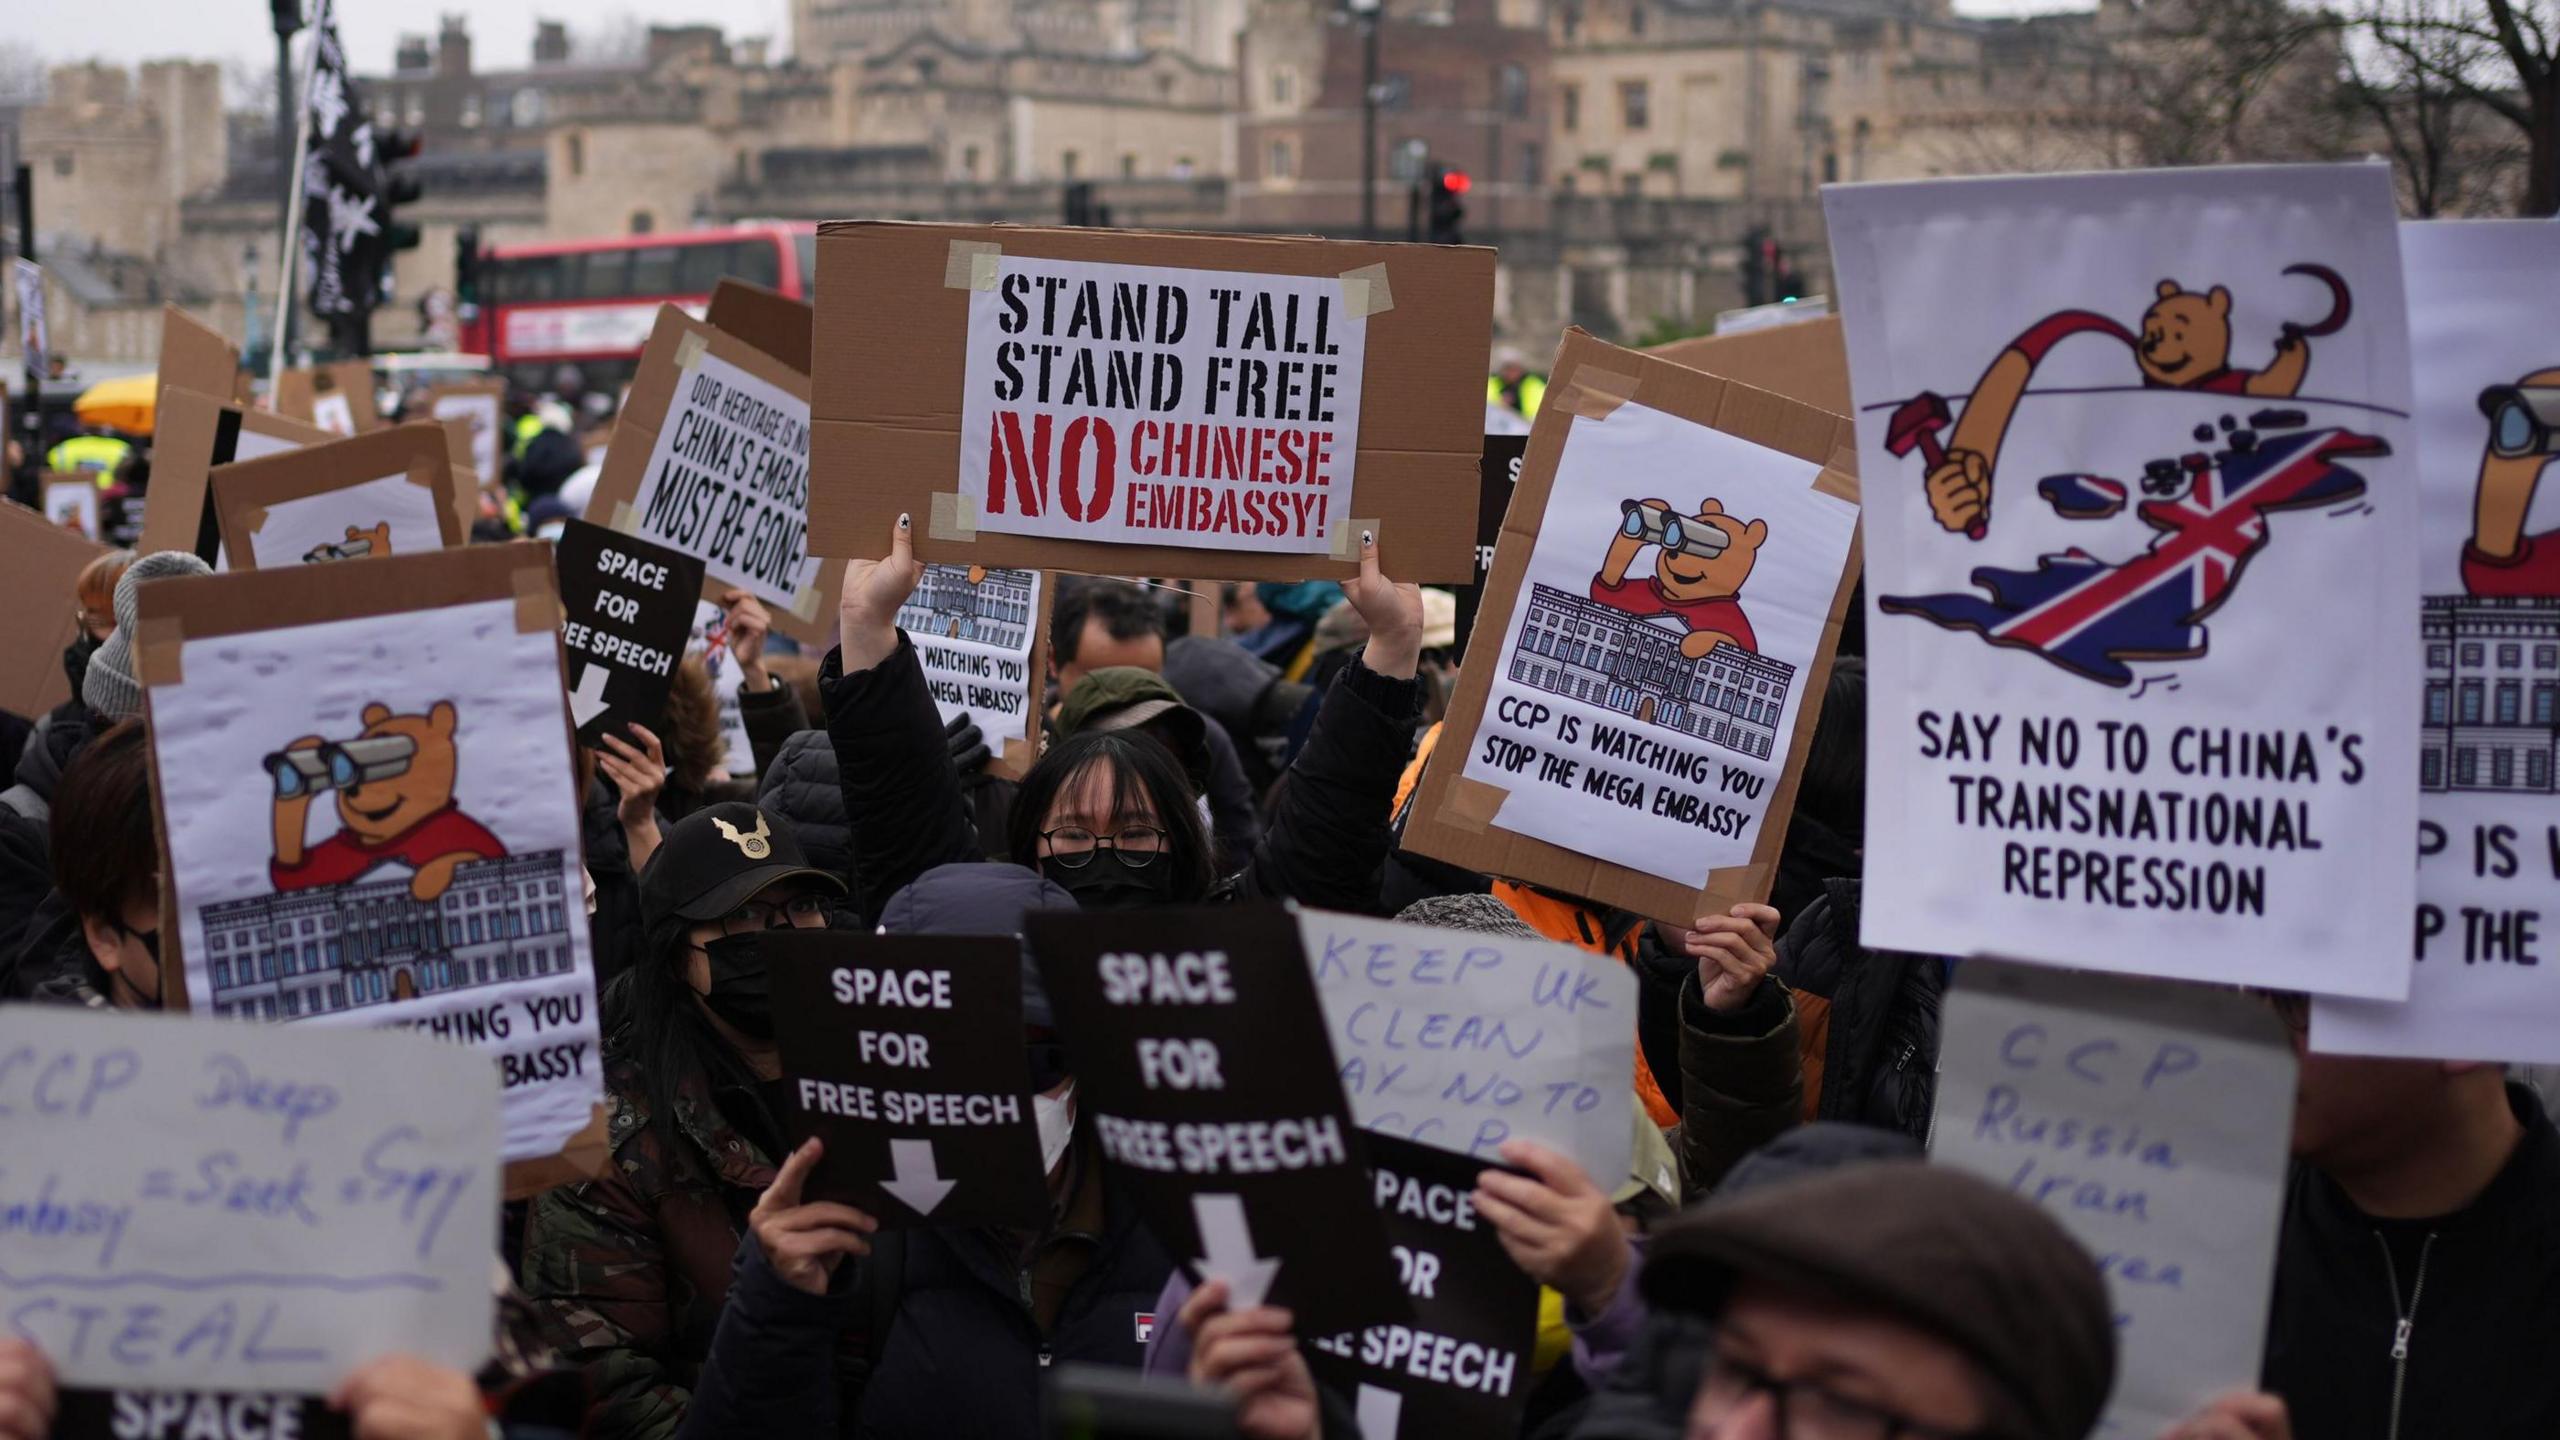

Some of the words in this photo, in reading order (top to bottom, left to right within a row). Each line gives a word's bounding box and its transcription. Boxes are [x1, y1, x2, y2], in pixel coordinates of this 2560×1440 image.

[999, 273, 1188, 344] STAND
[1210, 289, 1339, 355] TALL
[691, 374, 722, 413] OUR
[720, 387, 784, 442] HERITAGE
[778, 417, 796, 447] IS
[994, 341, 1184, 412] STAND
[1204, 356, 1338, 422] FREE
[673, 409, 754, 481] CHINA'S
[749, 447, 809, 515] EMBAS
[986, 410, 1117, 523] NO
[1130, 420, 1333, 486] CHINESE
[642, 459, 726, 551] MUST
[708, 490, 756, 567] BE
[1125, 483, 1328, 538] EMBASSY!
[597, 548, 669, 591] SPACE
[594, 589, 640, 624] FOR
[591, 631, 673, 677] SPEECH
[925, 646, 990, 678] WATCHING
[997, 658, 1022, 683] YOU
[968, 684, 1022, 716] EMBASSY
[1498, 695, 1550, 729] CCP
[1556, 714, 1582, 744] IS
[1590, 722, 1709, 785] WATCHING
[1720, 764, 1765, 800] YOU
[1917, 710, 2001, 762] SAY
[2020, 717, 2080, 770] NO
[2097, 721, 2149, 774] TO
[2170, 725, 2365, 785] CHINA'S
[1482, 735, 1537, 773] STOP
[1539, 752, 1579, 789] THE
[1582, 767, 1646, 811] MEGA
[1651, 786, 1751, 840] EMBASSY
[1949, 775, 2323, 852] TRANSNATIONAL
[2004, 842, 2265, 918] REPRESSION
[2475, 824, 2518, 879] IS
[2460, 906, 2540, 966] THE
[831, 967, 953, 1009] SPACE
[1098, 950, 1237, 1005] SPACE
[1317, 934, 1503, 987] KEEP
[1532, 962, 1611, 1013] UK
[405, 1003, 510, 1044] HING
[526, 994, 584, 1032] YOU
[1346, 1001, 1544, 1059] CLEAN
[498, 1042, 586, 1088] BASSY
[858, 1030, 931, 1069] FOR
[1137, 1038, 1225, 1090] FOR
[1998, 1023, 2200, 1089] CCP
[798, 1077, 878, 1120] FREE
[882, 1090, 1021, 1126] SPEECH
[1339, 1056, 1407, 1096] AY
[1441, 1071, 1525, 1107] NO
[1544, 1080, 1602, 1115] TO
[1094, 1112, 1178, 1172] FREE
[1174, 1115, 1346, 1174] SPEECH
[1973, 1083, 2183, 1171] Russia
[1370, 1167, 1477, 1231] PACE
[1391, 1245, 1441, 1299] OR
[2097, 1252, 2184, 1292] rea
[1360, 1324, 1517, 1398] SPEECH
[110, 1389, 304, 1440] SPACE
